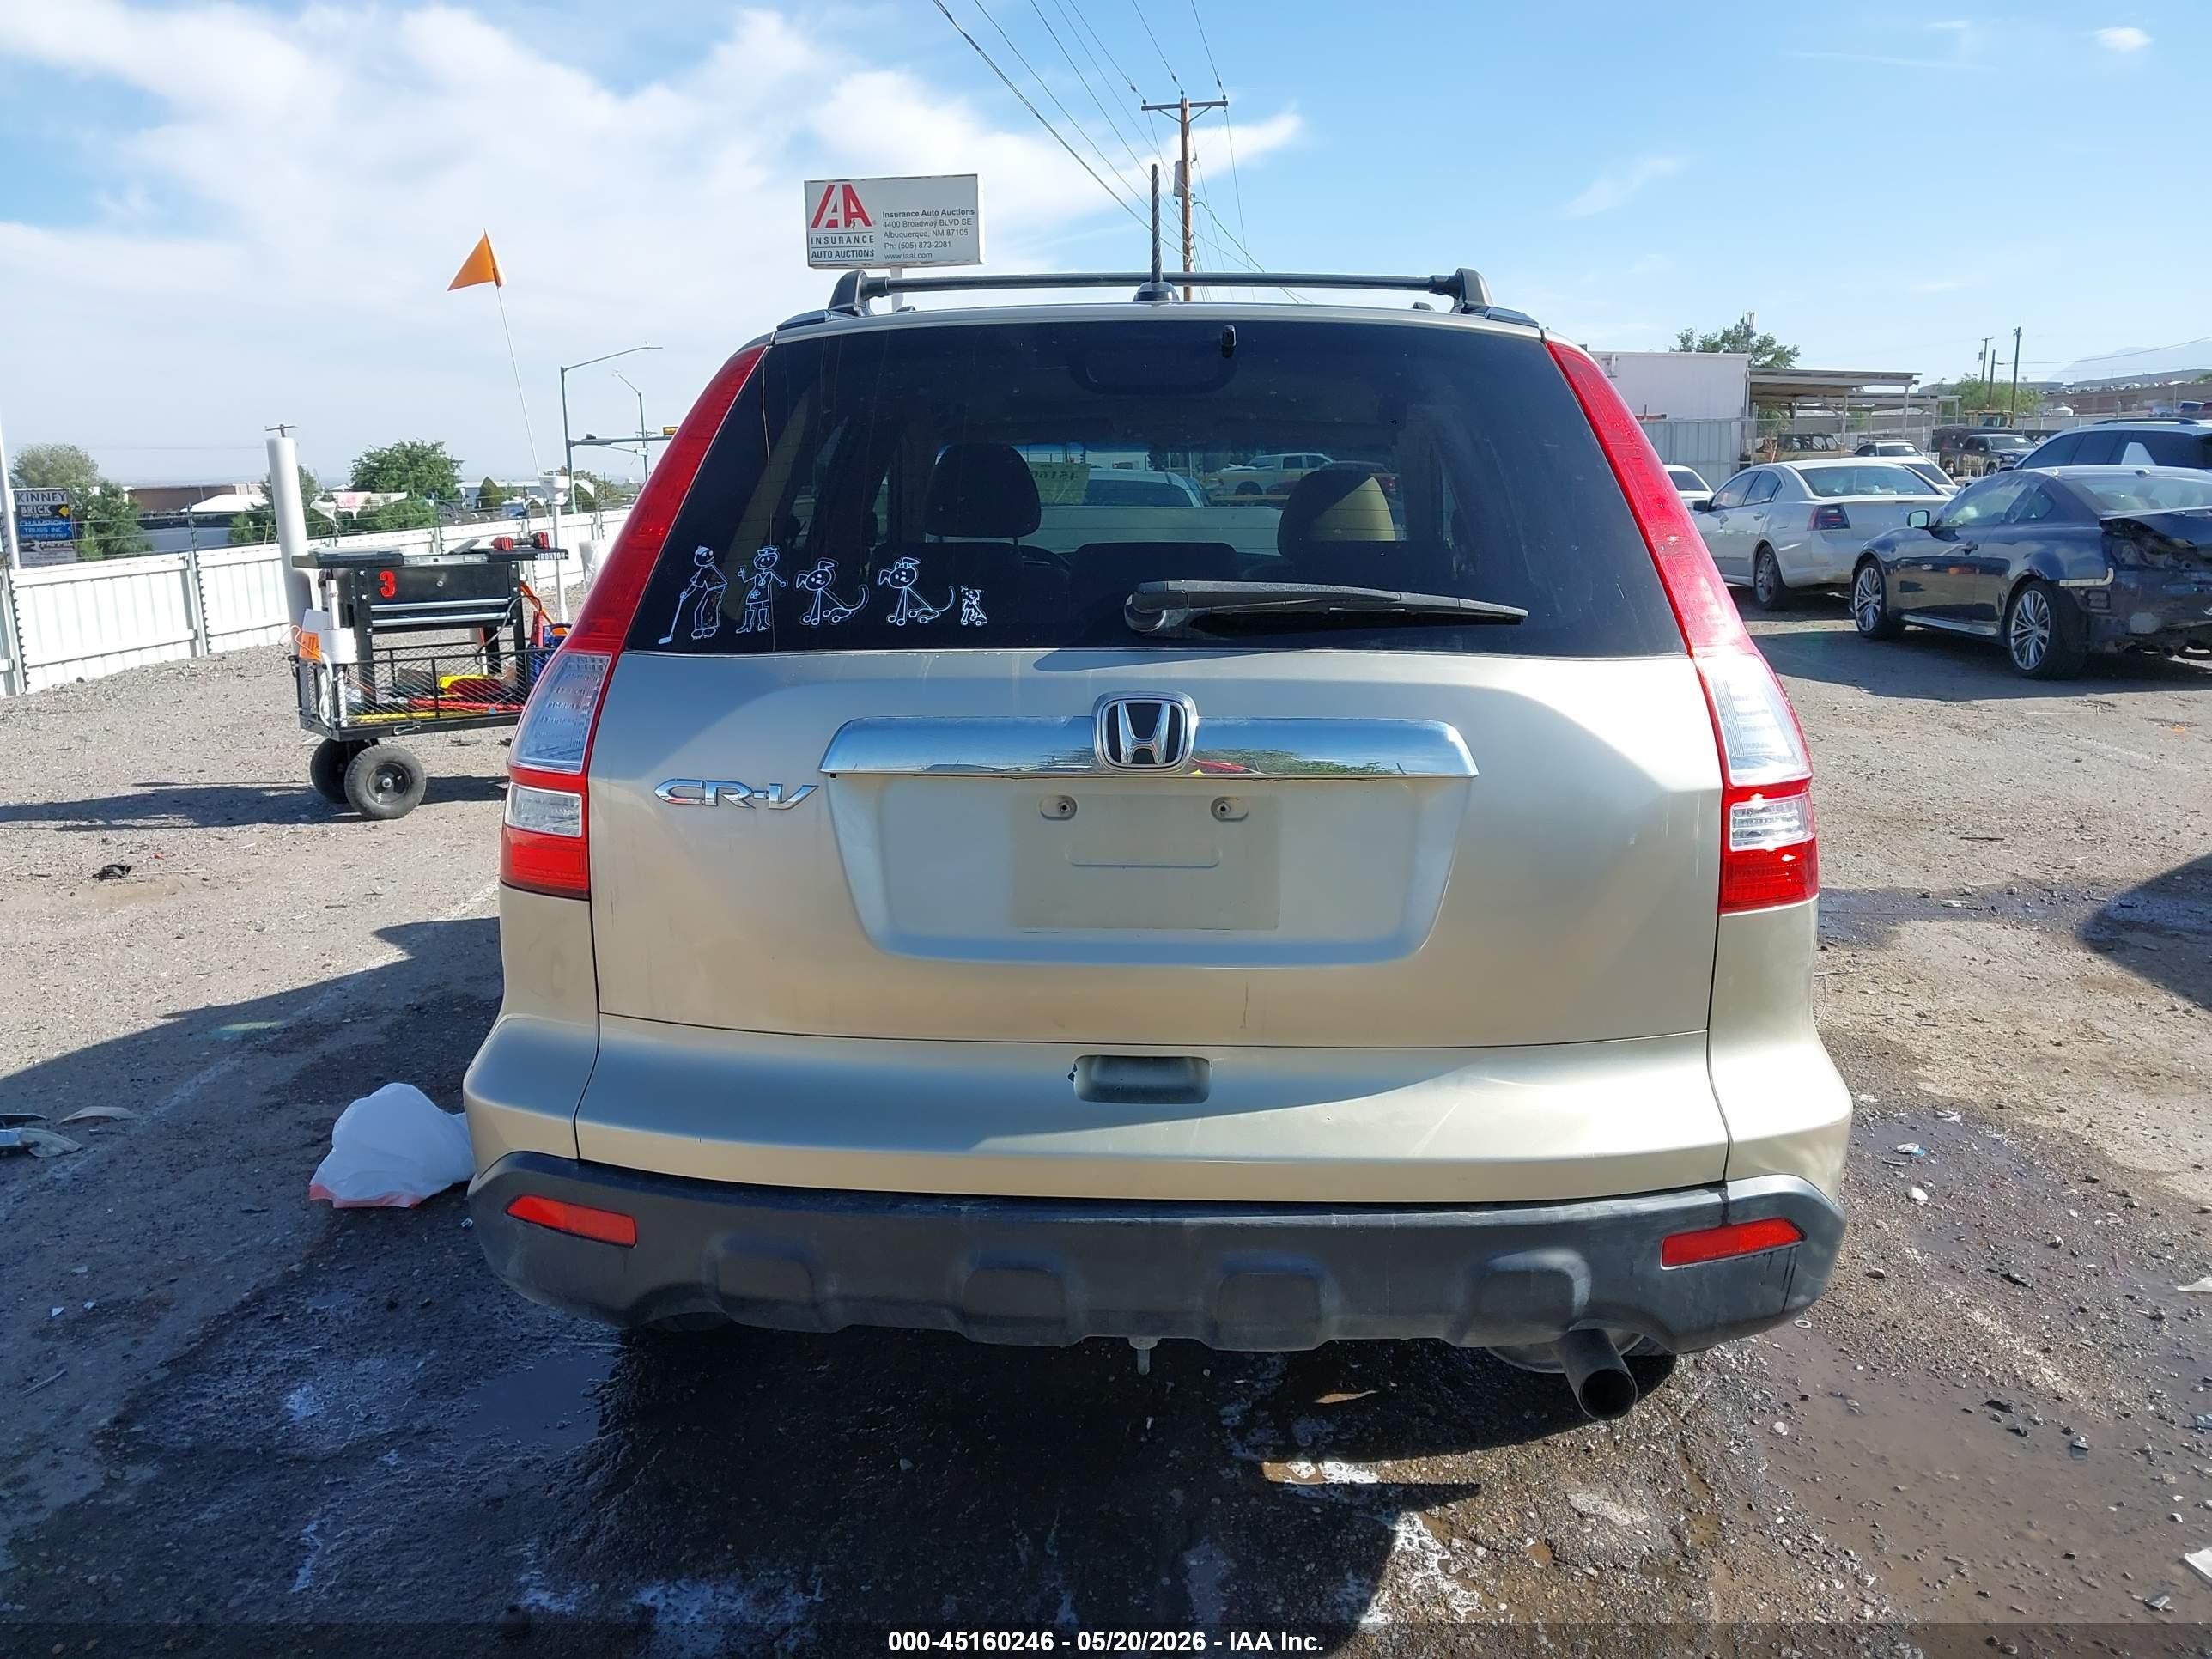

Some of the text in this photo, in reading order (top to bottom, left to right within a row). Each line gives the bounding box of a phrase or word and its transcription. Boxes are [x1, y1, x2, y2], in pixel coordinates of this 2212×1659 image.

[940, 208, 975, 216] Auctions
[902, 219, 937, 228] Broadway
[939, 218, 960, 227] BLVD
[811, 234, 874, 245] INSURANCE
[883, 230, 930, 240] Albuquerque,
[898, 241, 917, 251] (505)
[811, 248, 874, 259] AUTO AUCTIONS
[16, 492, 66, 502] KINNEY
[20, 505, 52, 514] BRICK
[380, 569, 396, 598] 3
[653, 778, 819, 810] CR-V
